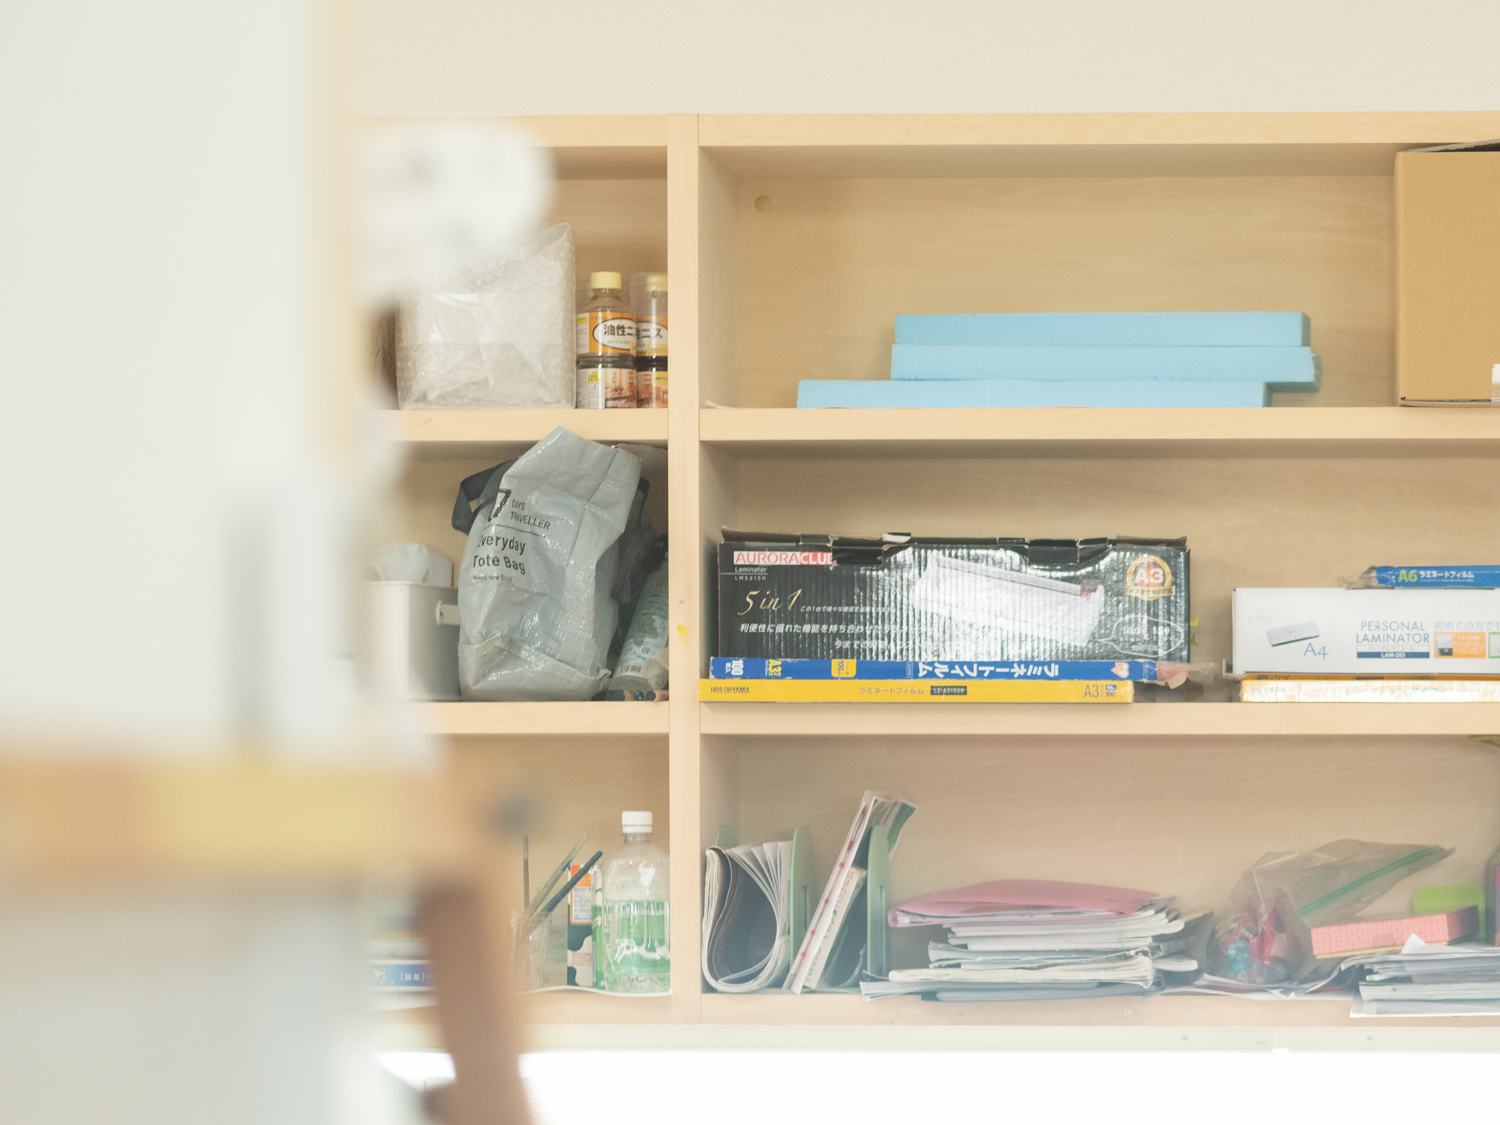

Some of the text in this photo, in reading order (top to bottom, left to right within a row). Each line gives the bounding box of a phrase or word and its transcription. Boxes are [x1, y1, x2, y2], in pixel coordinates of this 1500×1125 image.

[603, 323, 636, 336] 油性ニ
[478, 535, 526, 556] veryday
[473, 555, 525, 575] Tote Bag
[1134, 567, 1164, 583] A3
[1398, 569, 1418, 583] A6
[1419, 570, 1475, 579] ラミネートフィルム
[737, 589, 760, 616] 5
[759, 590, 782, 611] in
[1360, 621, 1426, 632] PERSONAL
[1356, 633, 1430, 644] LAMINATOR
[1303, 642, 1329, 660] A4
[731, 659, 744, 676] 100
[768, 659, 782, 672] A3
[917, 661, 1060, 679] ラミネートフィルム
[710, 686, 750, 694] IRIS OHYAMA
[859, 686, 925, 695] ラミネートフィルム
[1084, 683, 1099, 698] A3
